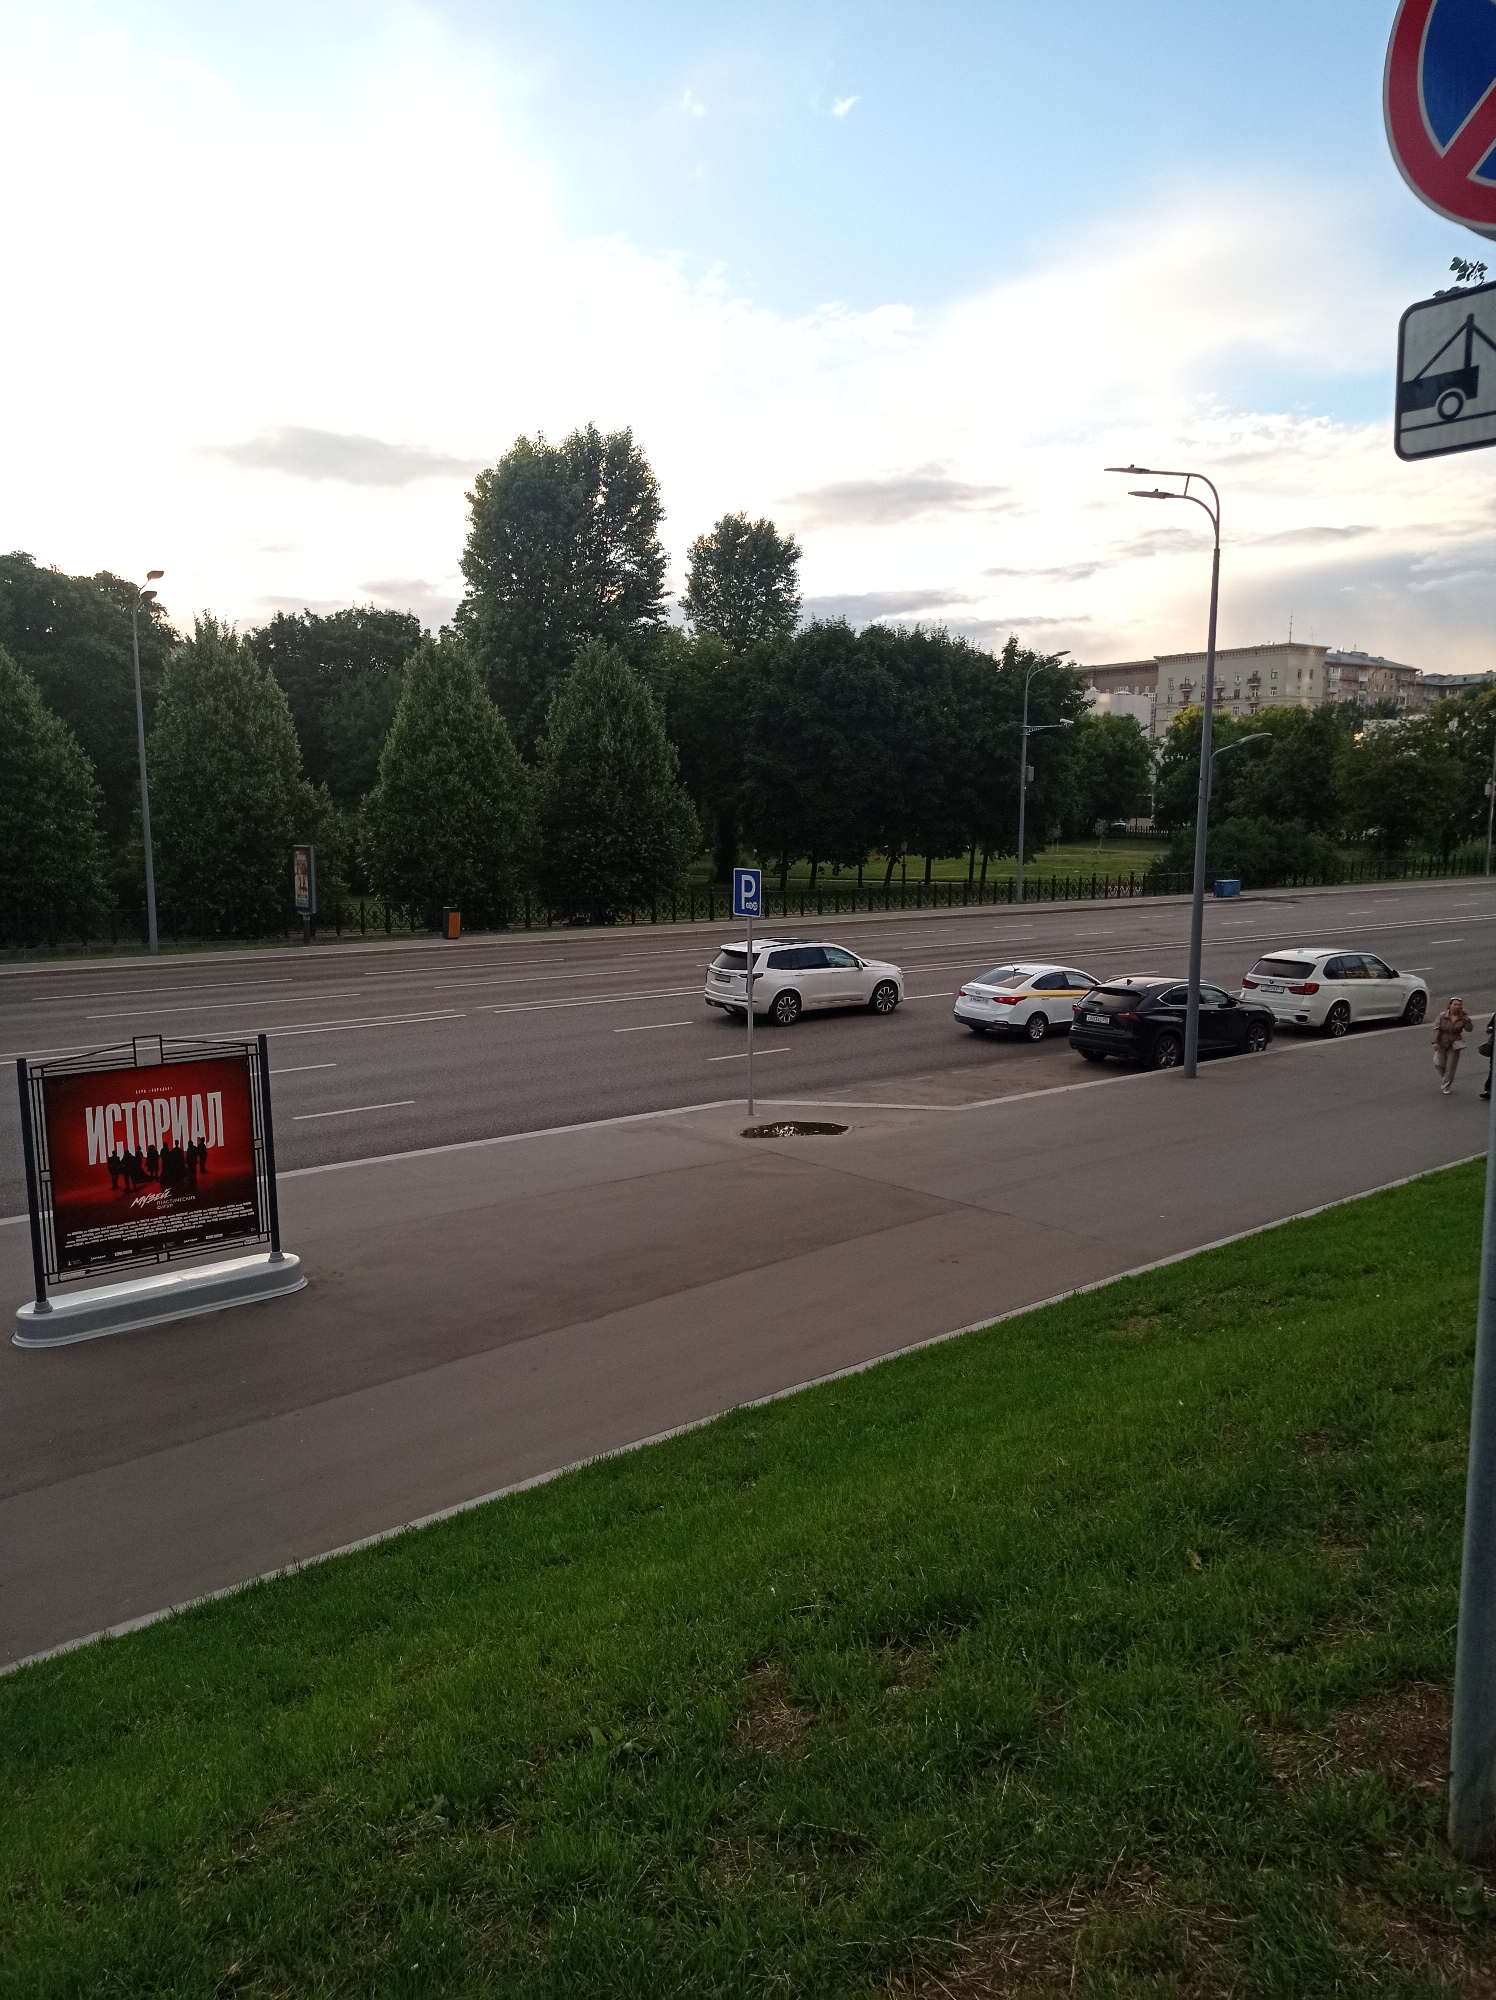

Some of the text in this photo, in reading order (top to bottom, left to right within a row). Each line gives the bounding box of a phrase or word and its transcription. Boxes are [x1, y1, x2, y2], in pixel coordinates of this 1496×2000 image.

[741, 874, 756, 910] P
[85, 1091, 225, 1166] ИСТОРИАЛ
[130, 1187, 172, 1208] МУЗЕЙ
